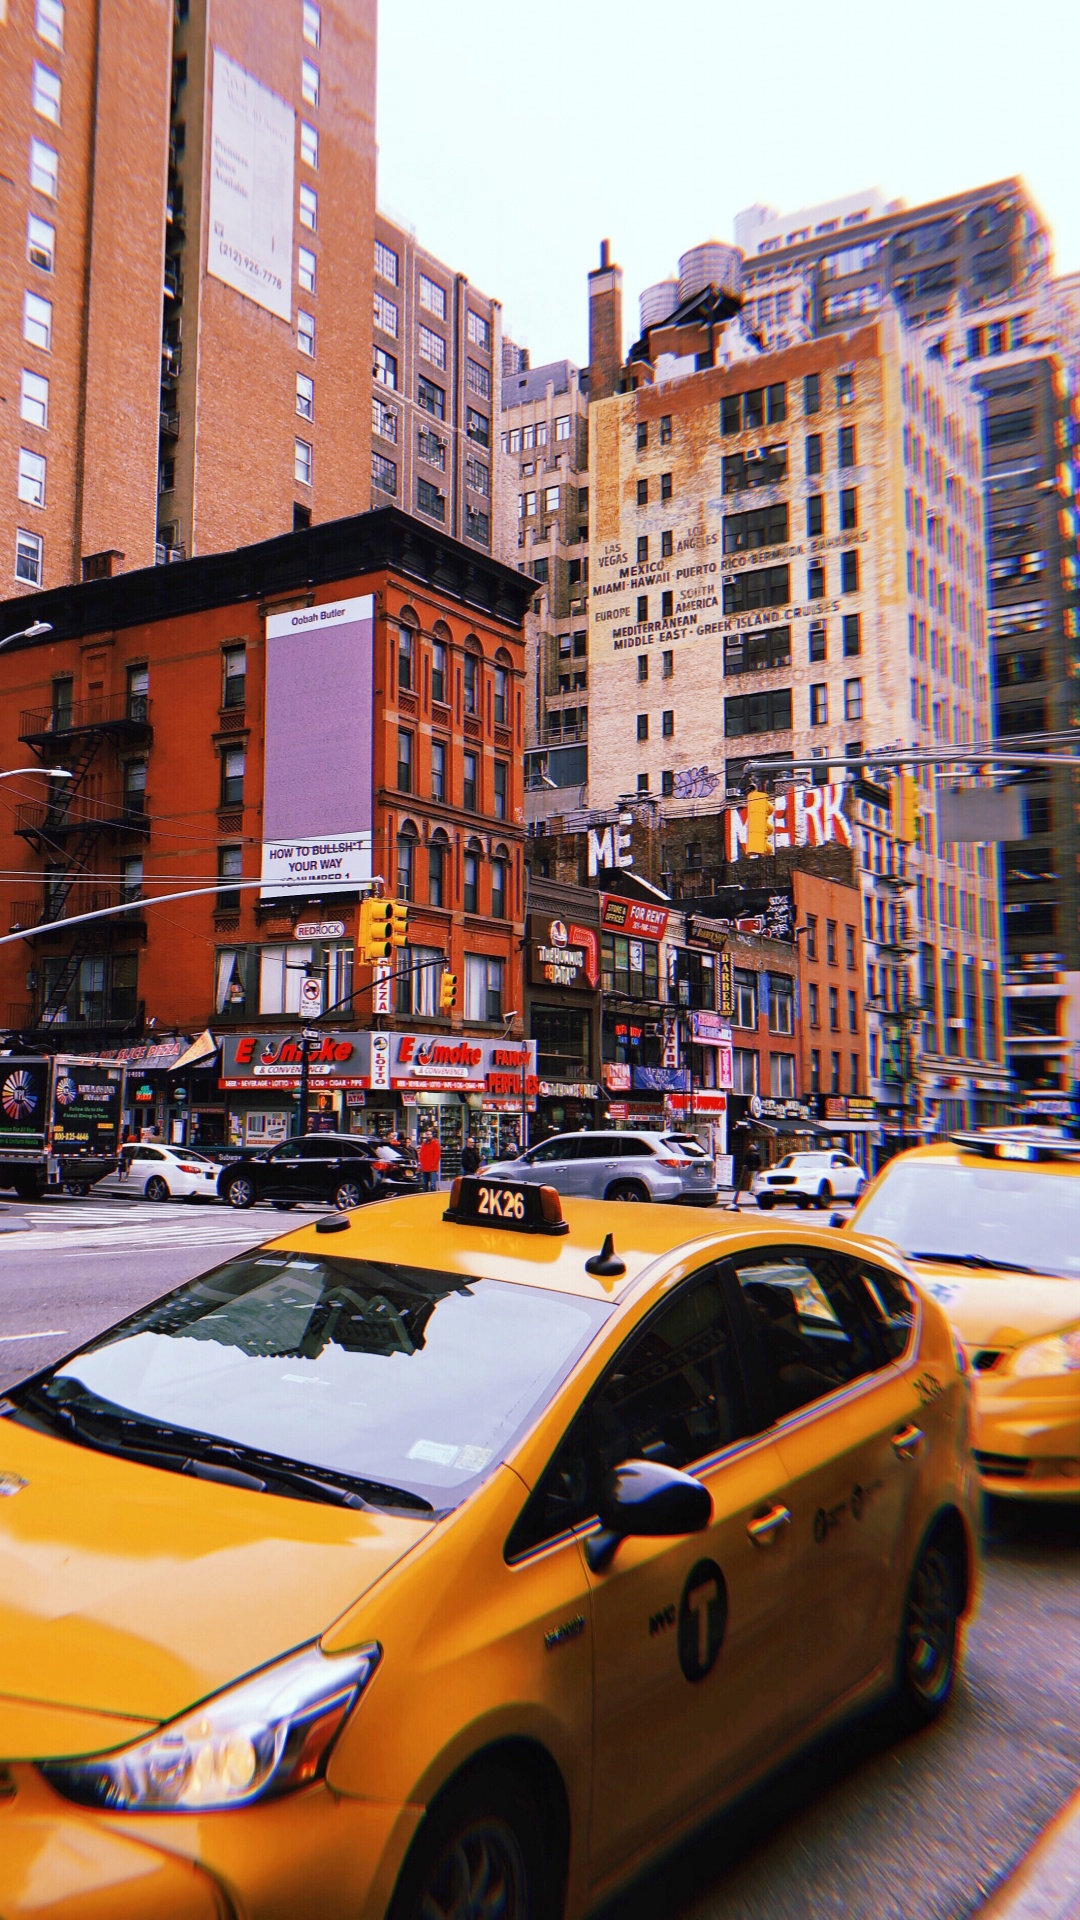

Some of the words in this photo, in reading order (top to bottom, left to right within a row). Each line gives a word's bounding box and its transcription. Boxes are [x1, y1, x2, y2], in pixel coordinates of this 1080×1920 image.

[219, 240, 242, 268] (212)
[604, 543, 622, 555] LAS
[676, 533, 718, 553] ANGELES
[597, 552, 629, 568] VEGAS
[619, 560, 665, 579] MEXICO
[592, 580, 626, 597] MIAMI
[630, 571, 671, 589] HAWAII
[676, 562, 717, 580] PUERTO
[720, 556, 747, 571] RICO
[679, 584, 715, 601] SOUTH
[594, 606, 631, 622] EUROPE
[674, 596, 719, 615] AMERICA
[291, 613, 319, 627] Oobah
[320, 608, 346, 620] Butler
[612, 613, 698, 639] MEDITERRANEAN
[613, 634, 655, 651] MIDDLE
[659, 627, 688, 642] EAST
[696, 620, 733, 636] GREEK
[736, 611, 780, 629] ISLAND
[269, 848, 294, 860] HOW
[296, 846, 310, 857] TO
[289, 860, 317, 872] YOUR
[320, 858, 343, 870] WAY
[630, 905, 646, 920] FOR
[646, 909, 666, 925] RENT
[298, 924, 341, 937] REDROCK
[721, 953, 731, 1011] BARBER
[116, 1046, 147, 1060] SLICE
[147, 1043, 180, 1058] PIZZA
[234, 1037, 257, 1063] E
[399, 1036, 416, 1062] E
[495, 1050, 532, 1067] FANCY
[259, 1066, 266, 1074] &
[267, 1065, 325, 1074] CONVENNCE
[375, 1053, 386, 1085] LOTTO
[488, 1073, 539, 1095] PERFUES
[348, 1094, 365, 1103] ATM
[218, 1153, 242, 1162] Subway
[477, 1187, 525, 1219] 2K26
